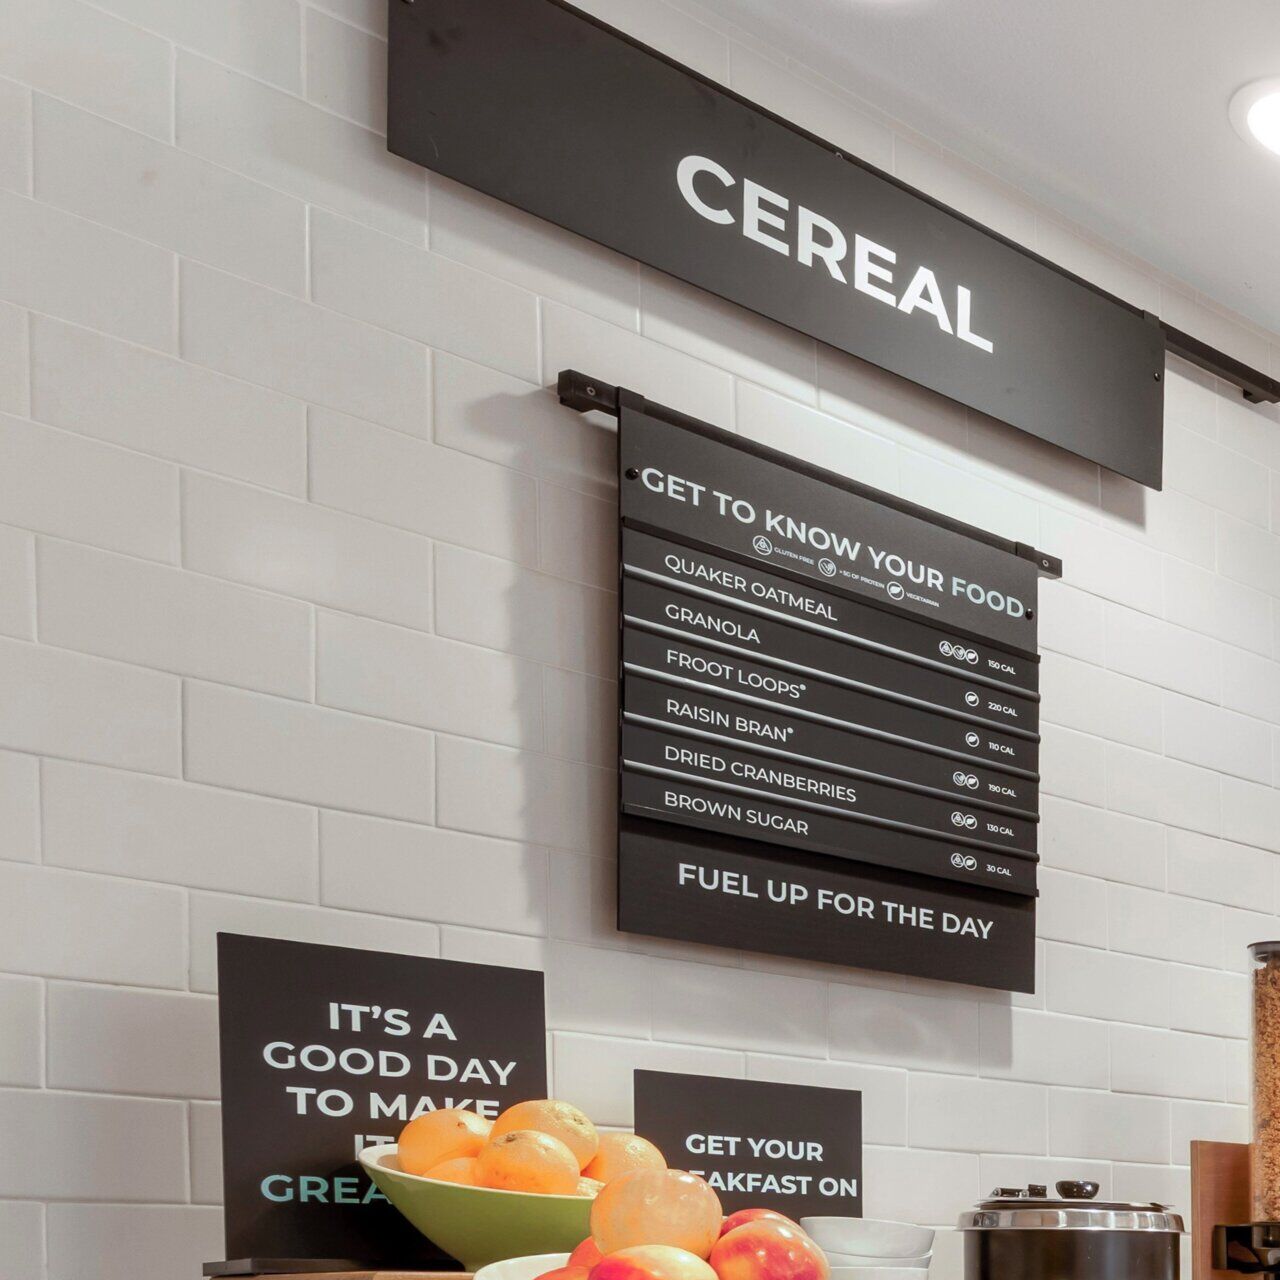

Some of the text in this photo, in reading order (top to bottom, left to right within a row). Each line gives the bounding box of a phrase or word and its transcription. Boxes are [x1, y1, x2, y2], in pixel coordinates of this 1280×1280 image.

[676, 154, 994, 354] CEREAL
[641, 467, 1024, 618] GET TO KNOW YOUR FOOD
[774, 547, 815, 566] GLUTEN FREE
[664, 554, 838, 621] QUAKER OATMEAL
[860, 576, 885, 589] PROTEIN
[906, 591, 940, 608] VEGETARIAN
[665, 604, 761, 644] GRANOLA
[666, 649, 734, 680] FROOT
[987, 659, 1017, 675] 150 CAL
[666, 699, 730, 728] RAISIN
[988, 701, 1018, 717] 220 CAL
[1000, 745, 1016, 756] CAL
[664, 745, 857, 803] DRIED CRANBERRIES
[988, 783, 1017, 798] 190 CAL
[664, 791, 809, 836] BROWN SUGAR
[986, 823, 1015, 837] 130 CAL
[986, 864, 1012, 877] 30 CAL
[678, 862, 994, 940] FUEL UP FOR THE DAY
[329, 1002, 458, 1041] IT'S A
[262, 1041, 517, 1086] GOOD DAY
[285, 1085, 354, 1117] TO
[685, 1133, 823, 1162] GET YOUR
[688, 1170, 858, 1198] AKFAST ON
